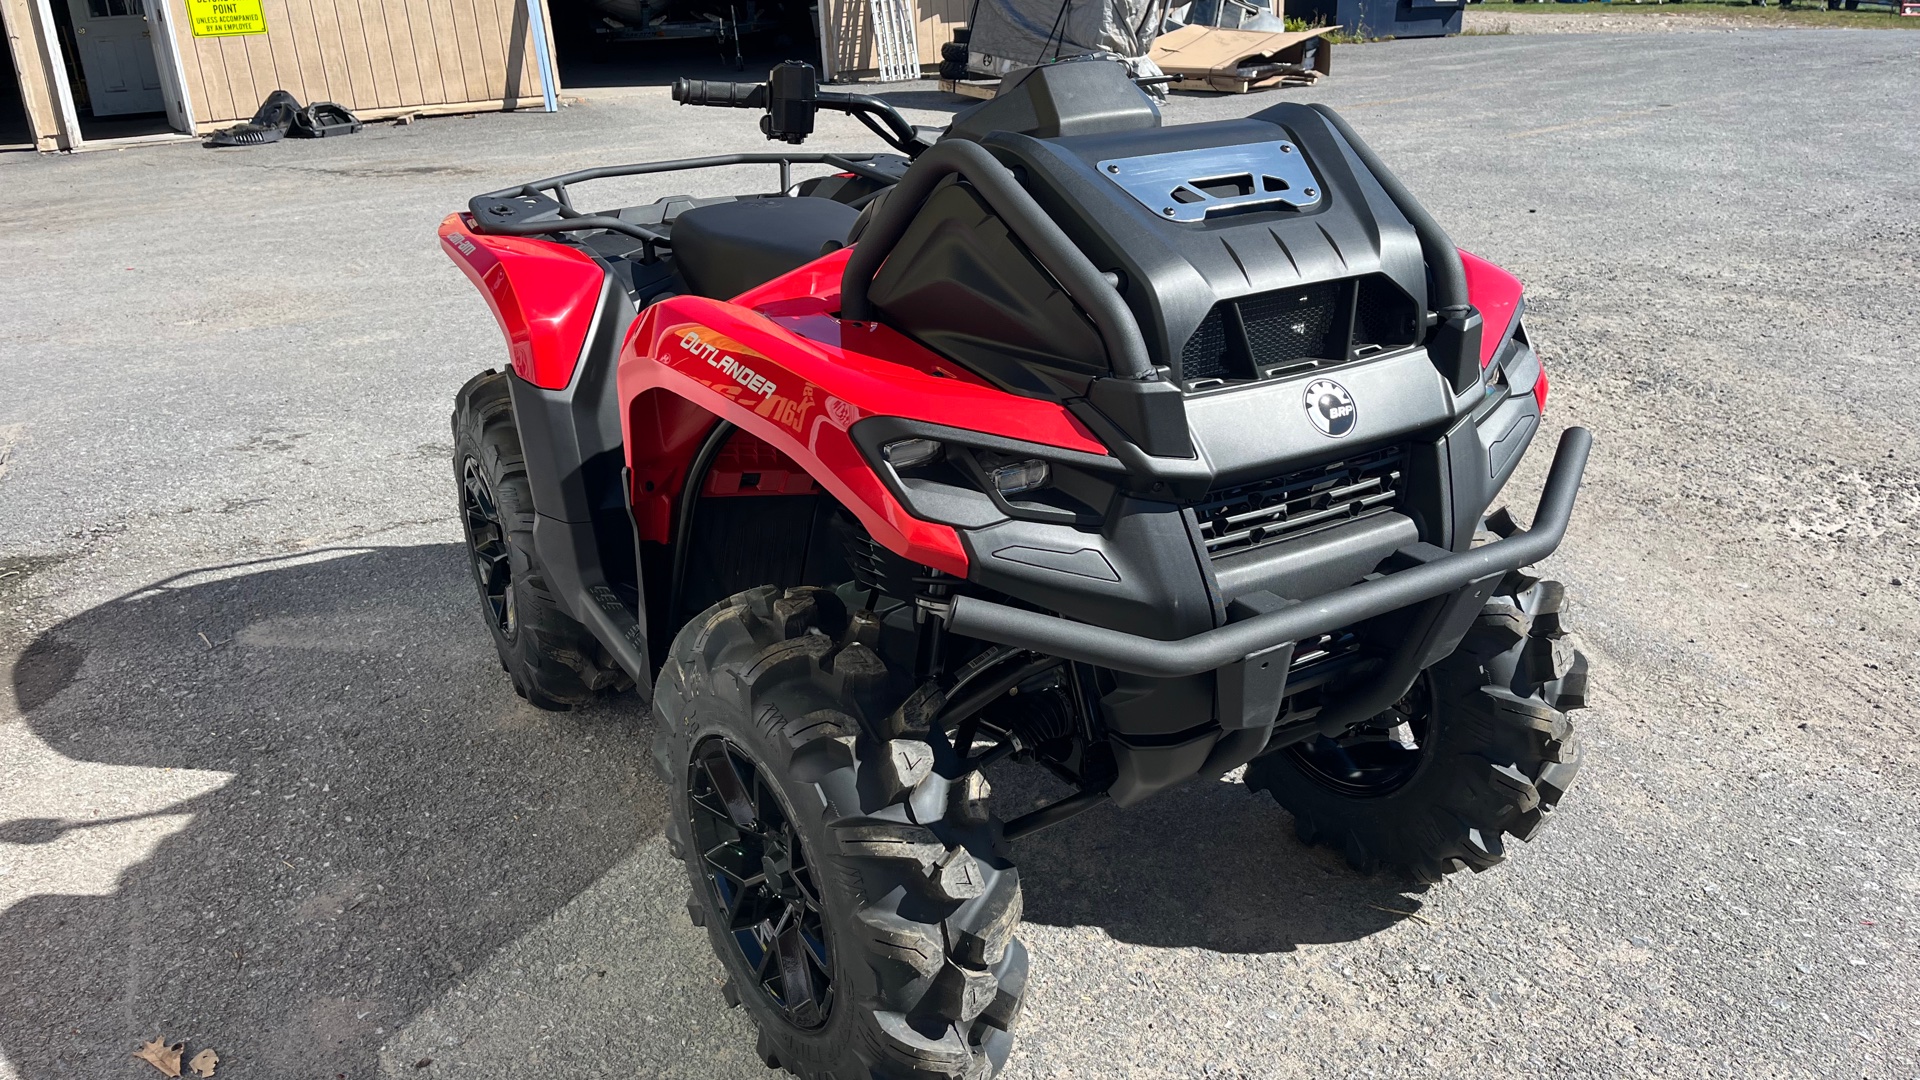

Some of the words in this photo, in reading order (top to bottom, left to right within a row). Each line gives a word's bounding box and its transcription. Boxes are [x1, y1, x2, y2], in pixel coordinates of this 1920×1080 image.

[213, 4, 237, 14] POINT
[197, 16, 218, 24] UNLESS
[219, 14, 259, 23] ACCOMPANIED
[224, 23, 252, 31] EMPLOYEE
[679, 331, 777, 399] OUTLANDER
[1330, 405, 1353, 419] BRP
